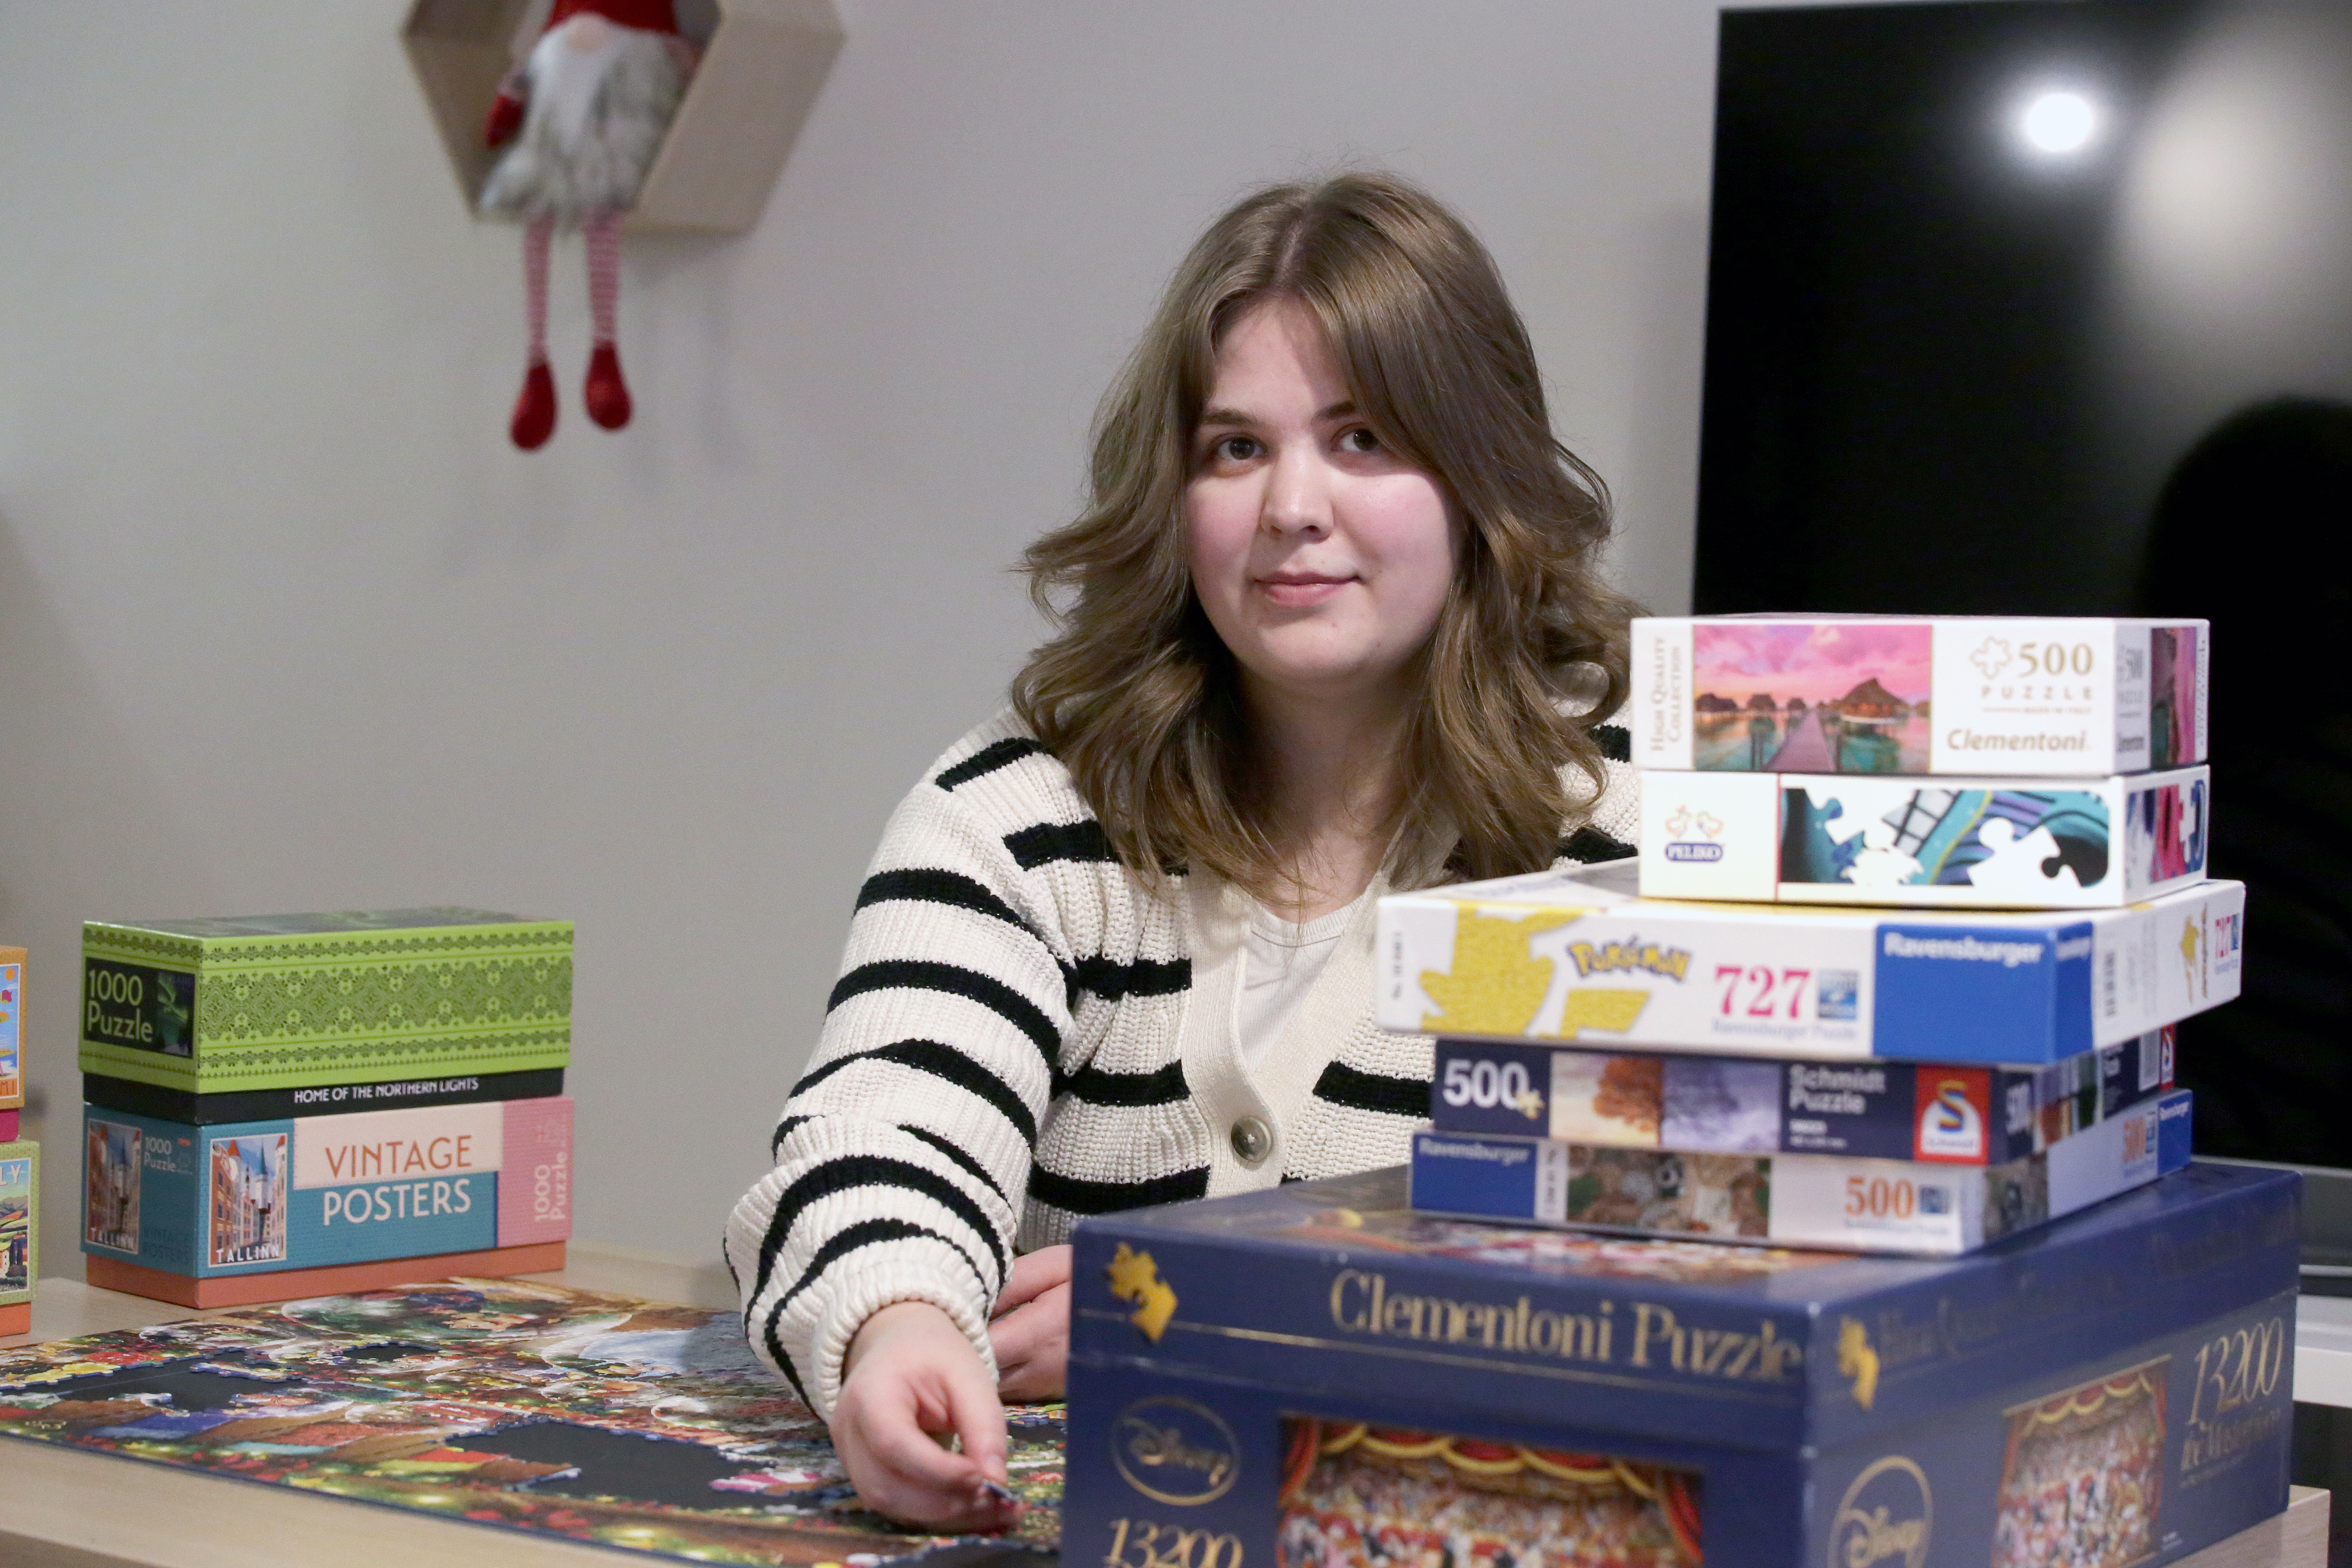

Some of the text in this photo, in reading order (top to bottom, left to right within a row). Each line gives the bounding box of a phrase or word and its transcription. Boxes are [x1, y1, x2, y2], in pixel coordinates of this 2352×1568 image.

[2019, 641, 2094, 678] 500
[1981, 685, 2093, 700] PUZZLE
[1947, 728, 2087, 751] Clementoni
[1884, 931, 2045, 968] Ravensburger
[88, 969, 143, 1006] 1000
[1715, 965, 1811, 1019] 727
[87, 1000, 153, 1043] Puzzle
[294, 1077, 479, 1104] HOME OF THE NORTHERN LIGHTS
[1443, 1058, 1530, 1110] 500
[1790, 1063, 1887, 1094] Schmidt
[1789, 1084, 1866, 1115] Puzzle
[143, 1151, 177, 1173] Puzzle
[144, 1137, 171, 1155] 1000
[324, 1135, 472, 1178] VINTAGE
[1418, 1137, 1530, 1167] Ravensburger
[324, 1179, 471, 1226] POSTERS
[534, 1164, 551, 1221] 1000
[551, 1151, 567, 1220] Puzzle
[1845, 1174, 1914, 1220] 500
[215, 1245, 280, 1263] TALLINN
[1329, 1268, 1613, 1365] Clementoni
[1631, 1299, 1806, 1383] Puzzle
[2188, 1317, 2284, 1426] 13200
[1104, 1518, 1244, 1568] 13200
